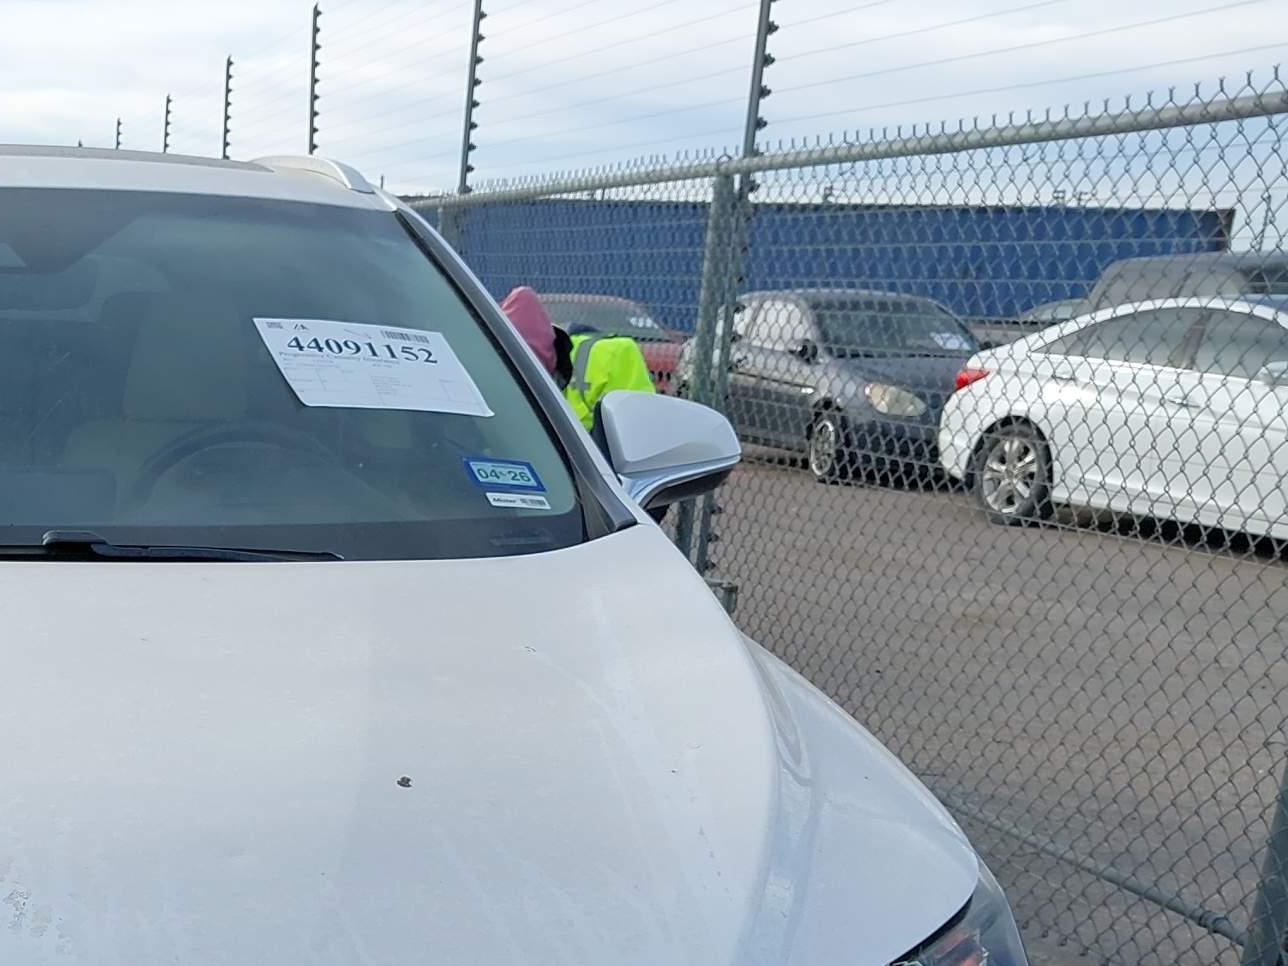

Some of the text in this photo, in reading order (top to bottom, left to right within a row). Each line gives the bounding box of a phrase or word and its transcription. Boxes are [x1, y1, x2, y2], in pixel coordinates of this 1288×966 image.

[287, 335, 438, 365] 44091152
[476, 467, 532, 483] 04 26
